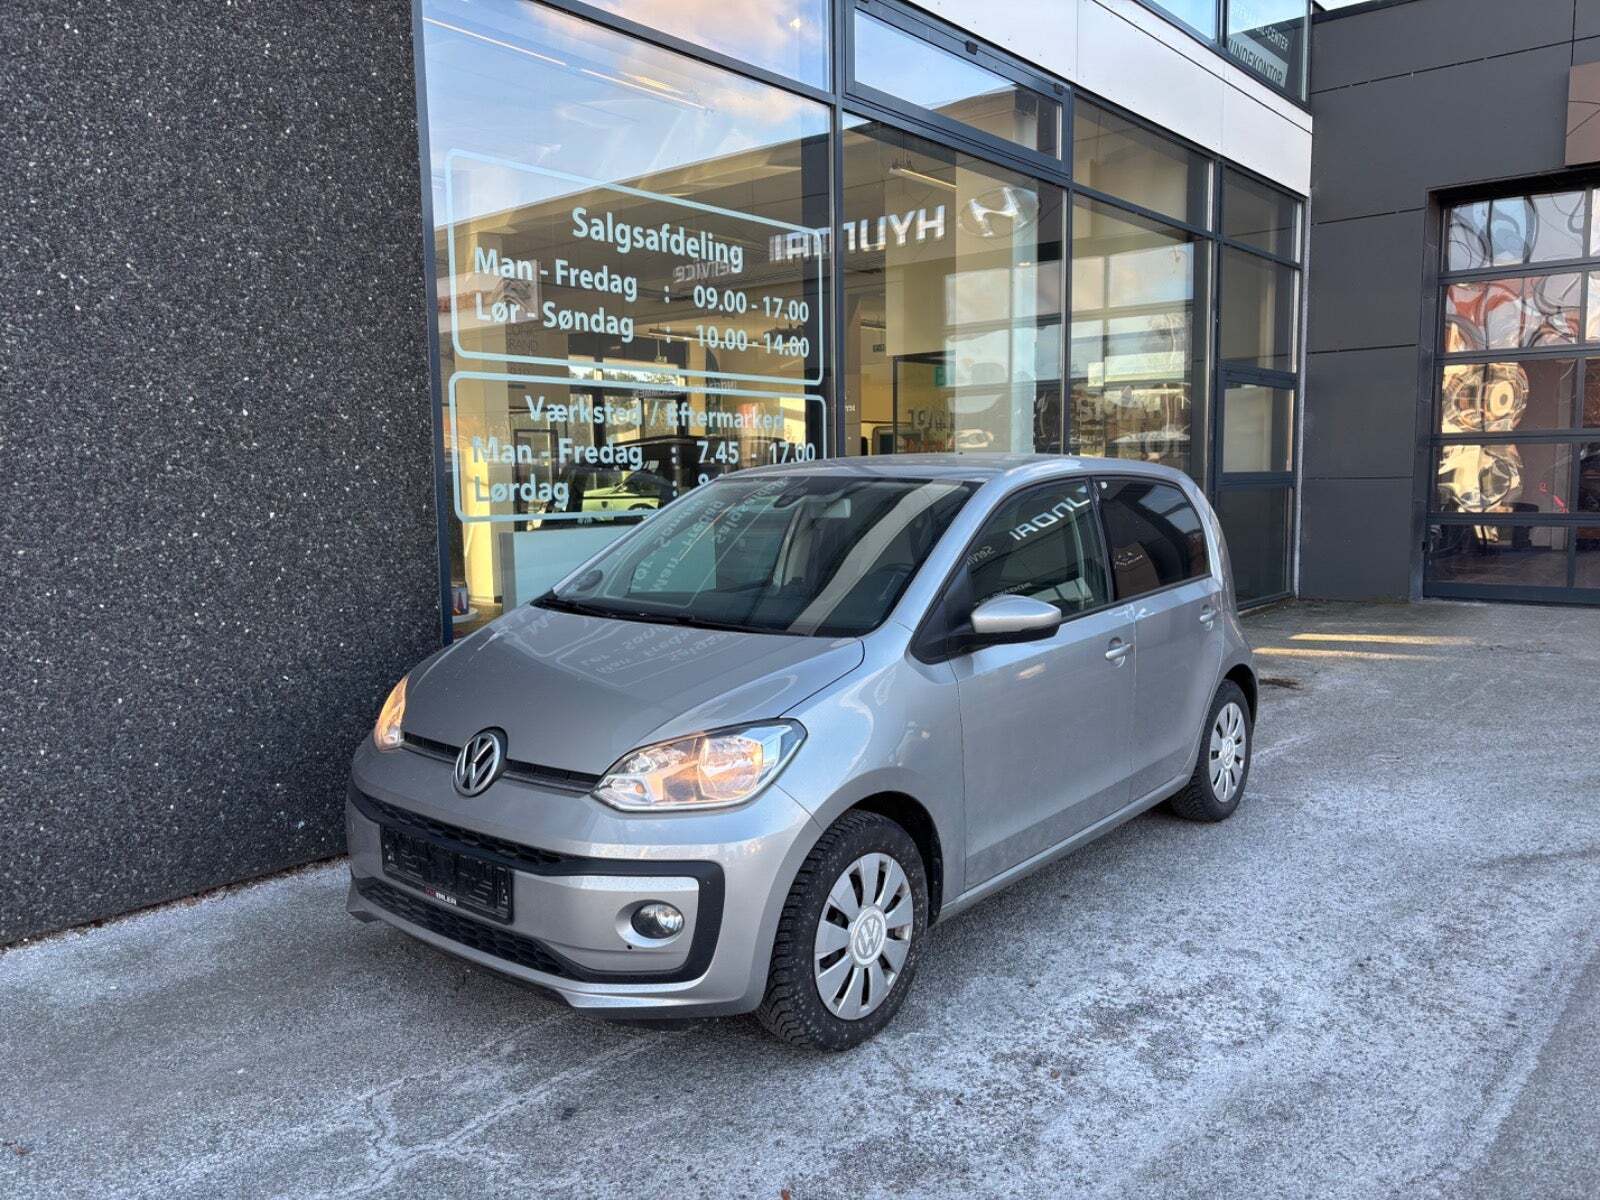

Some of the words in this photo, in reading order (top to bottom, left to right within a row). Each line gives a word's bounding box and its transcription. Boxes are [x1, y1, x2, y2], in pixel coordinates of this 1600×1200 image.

[571, 206, 744, 273] Salgsafdeling
[473, 246, 533, 281] Man
[555, 258, 638, 302] Fredag
[693, 284, 747, 314] 09.00
[762, 295, 810, 323] 17.00
[476, 291, 520, 323] Lør
[542, 300, 635, 344] Søndag
[695, 324, 748, 351] 10.00
[763, 332, 810, 358] 14.00
[525, 394, 642, 427] Værksted
[666, 400, 784, 430] Eftermarked
[472, 437, 532, 464] Man
[558, 437, 643, 472] Fredag
[696, 440, 740, 465] 7.45
[769, 441, 816, 465] 17.00
[474, 475, 570, 508] Lørdag
